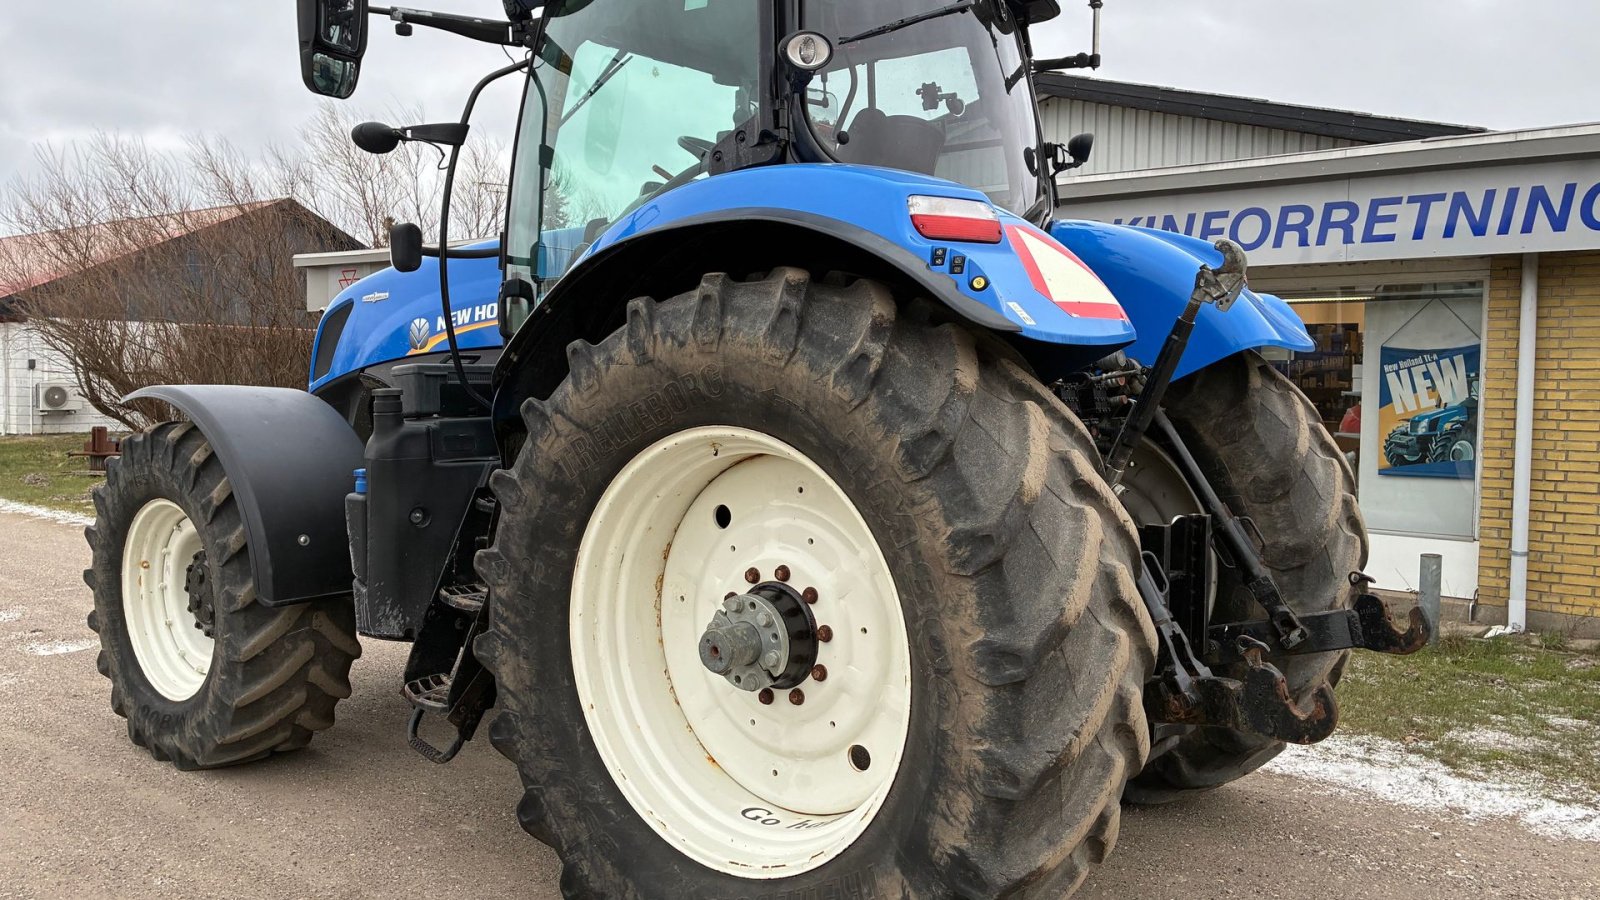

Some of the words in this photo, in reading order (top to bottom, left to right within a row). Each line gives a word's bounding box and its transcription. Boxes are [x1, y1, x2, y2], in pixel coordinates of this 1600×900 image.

[436, 307, 472, 331] NEW
[474, 302, 499, 321] HO
[1384, 363, 1399, 373] New
[1398, 355, 1424, 369] Holland
[1386, 354, 1469, 414] NEW
[554, 363, 726, 480] TRELLEBORG
[741, 807, 780, 825] Go
